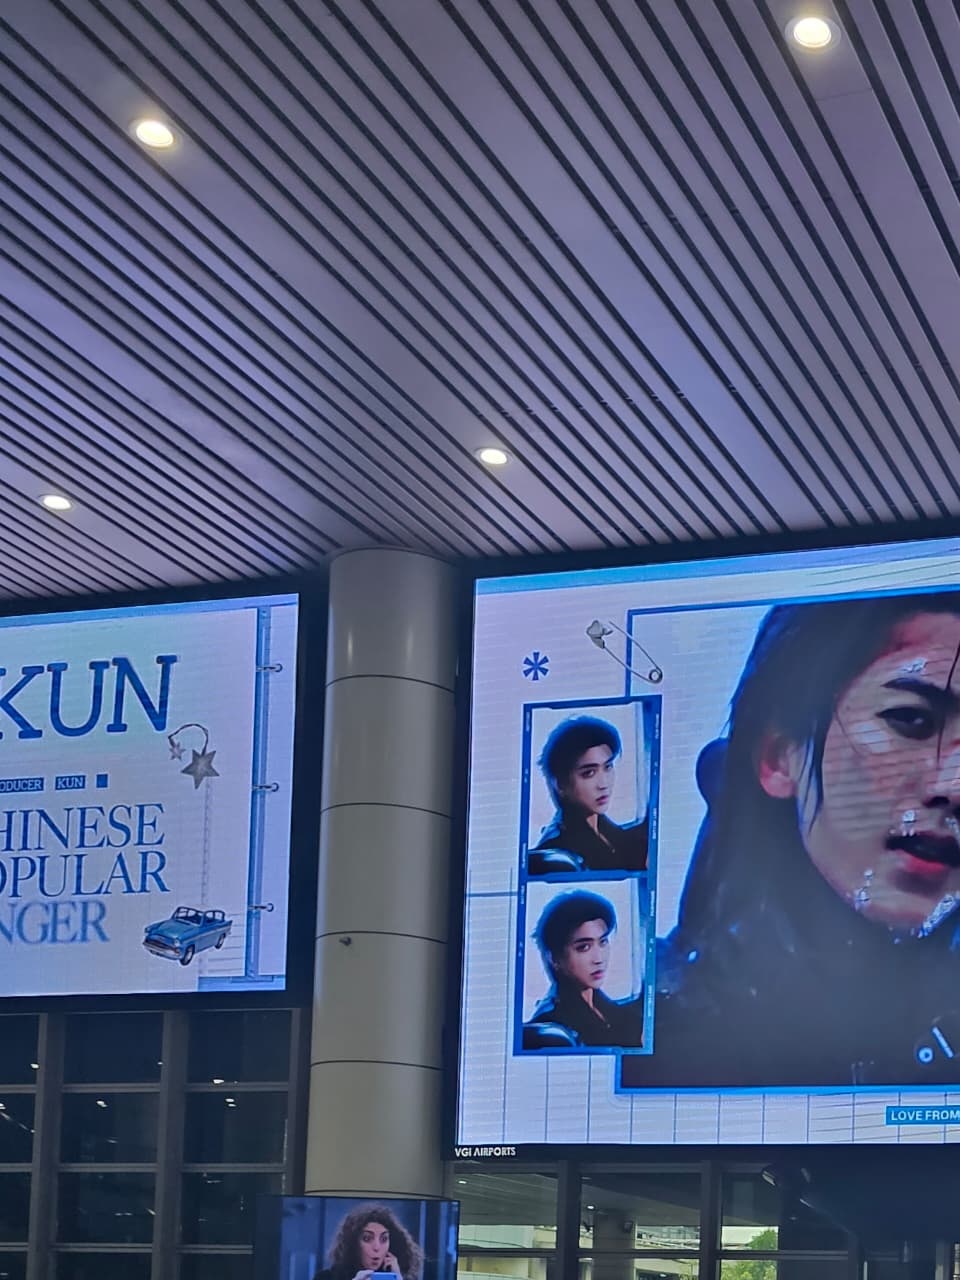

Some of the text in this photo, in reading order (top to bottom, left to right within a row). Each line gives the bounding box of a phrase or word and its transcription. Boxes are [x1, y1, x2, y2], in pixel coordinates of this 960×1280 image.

[0, 655, 177, 740] KUN
[57, 776, 84, 789] KUN
[0, 850, 170, 898] PULAR
[891, 1110, 923, 1121] LOVE
[925, 1109, 960, 1120] FROM
[455, 1147, 516, 1157] VGI AIRPORTS
